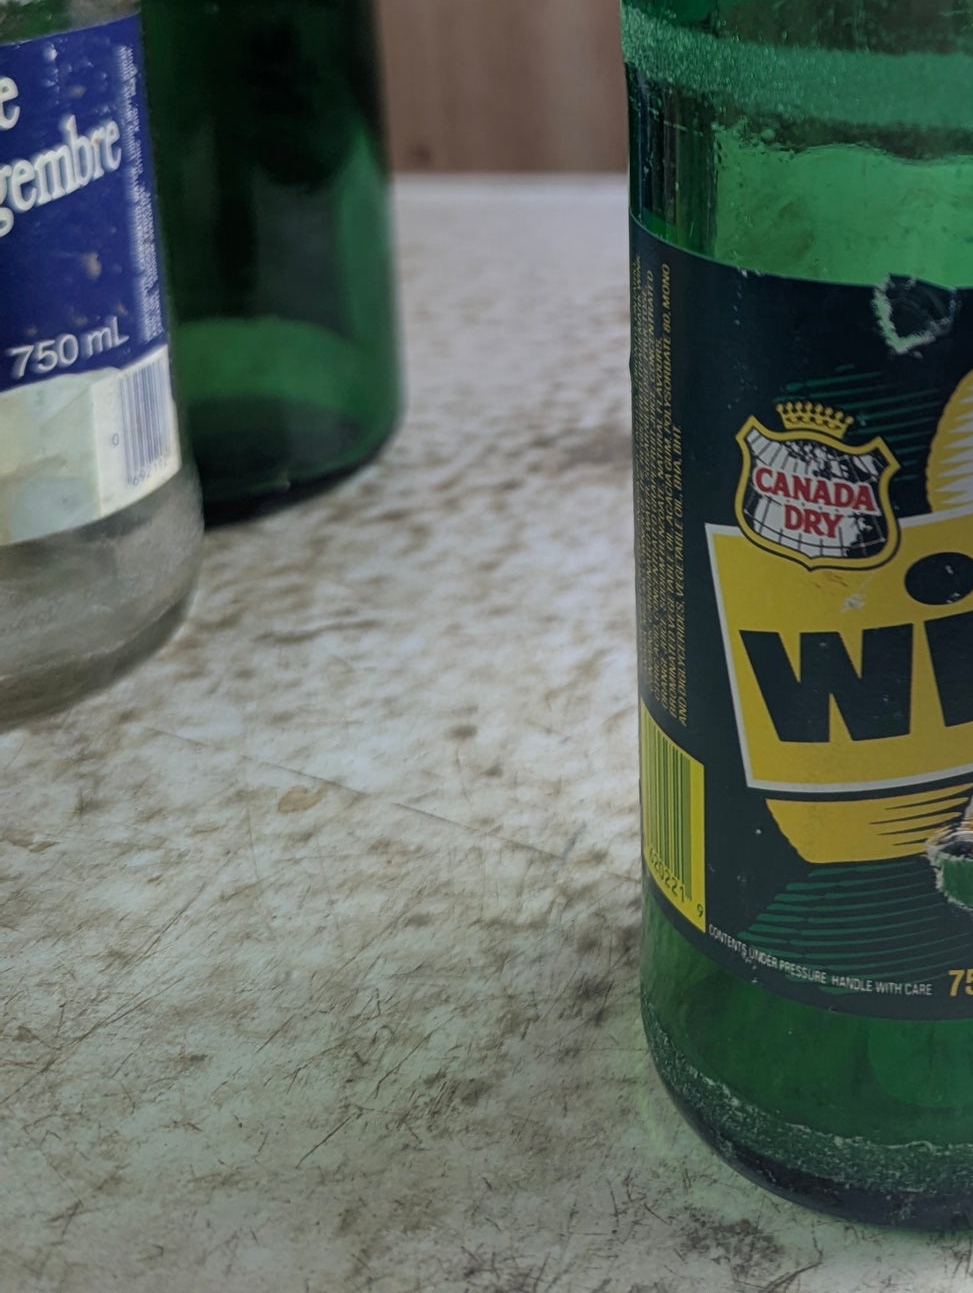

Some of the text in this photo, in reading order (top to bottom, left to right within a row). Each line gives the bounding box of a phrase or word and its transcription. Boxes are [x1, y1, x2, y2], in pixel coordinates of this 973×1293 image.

[661, 263, 670, 309] MONO
[10, 315, 130, 379] 750 mL
[755, 468, 876, 512] CANADA
[784, 504, 844, 539] DRY
[678, 697, 687, 727] AND
[696, 903, 704, 917] 9
[708, 923, 933, 996] CONTENTS UNDER PRESSURE HANDLE WITH CARE
